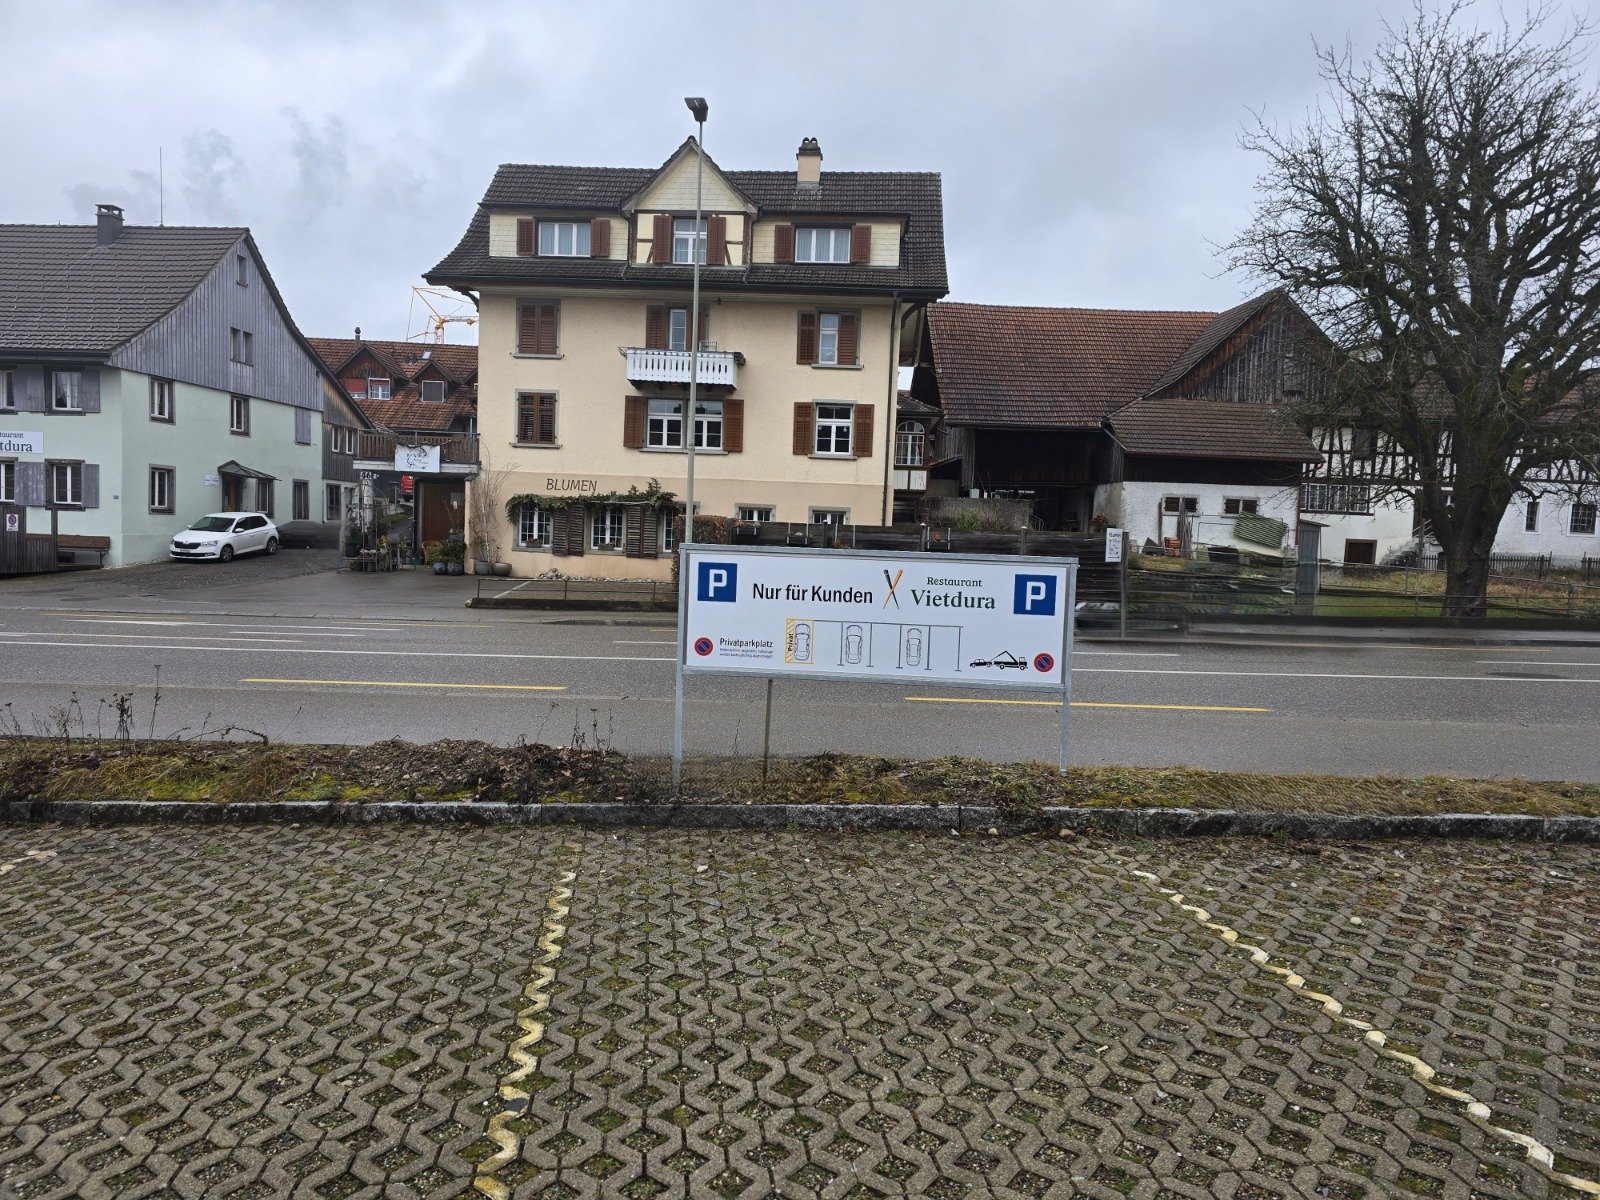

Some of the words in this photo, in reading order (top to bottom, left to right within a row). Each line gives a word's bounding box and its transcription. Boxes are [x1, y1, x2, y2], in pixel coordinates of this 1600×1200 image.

[0, 440, 32, 451] tdura
[546, 478, 597, 491] BLUMEN
[708, 569, 727, 597] P
[926, 576, 983, 588] Restaurant
[753, 583, 781, 600] Nur
[786, 585, 807, 601] für
[811, 585, 873, 604] Kunden
[911, 589, 996, 610] Vietdura
[1025, 581, 1047, 611] P
[719, 638, 773, 648] Privatparkplatz
